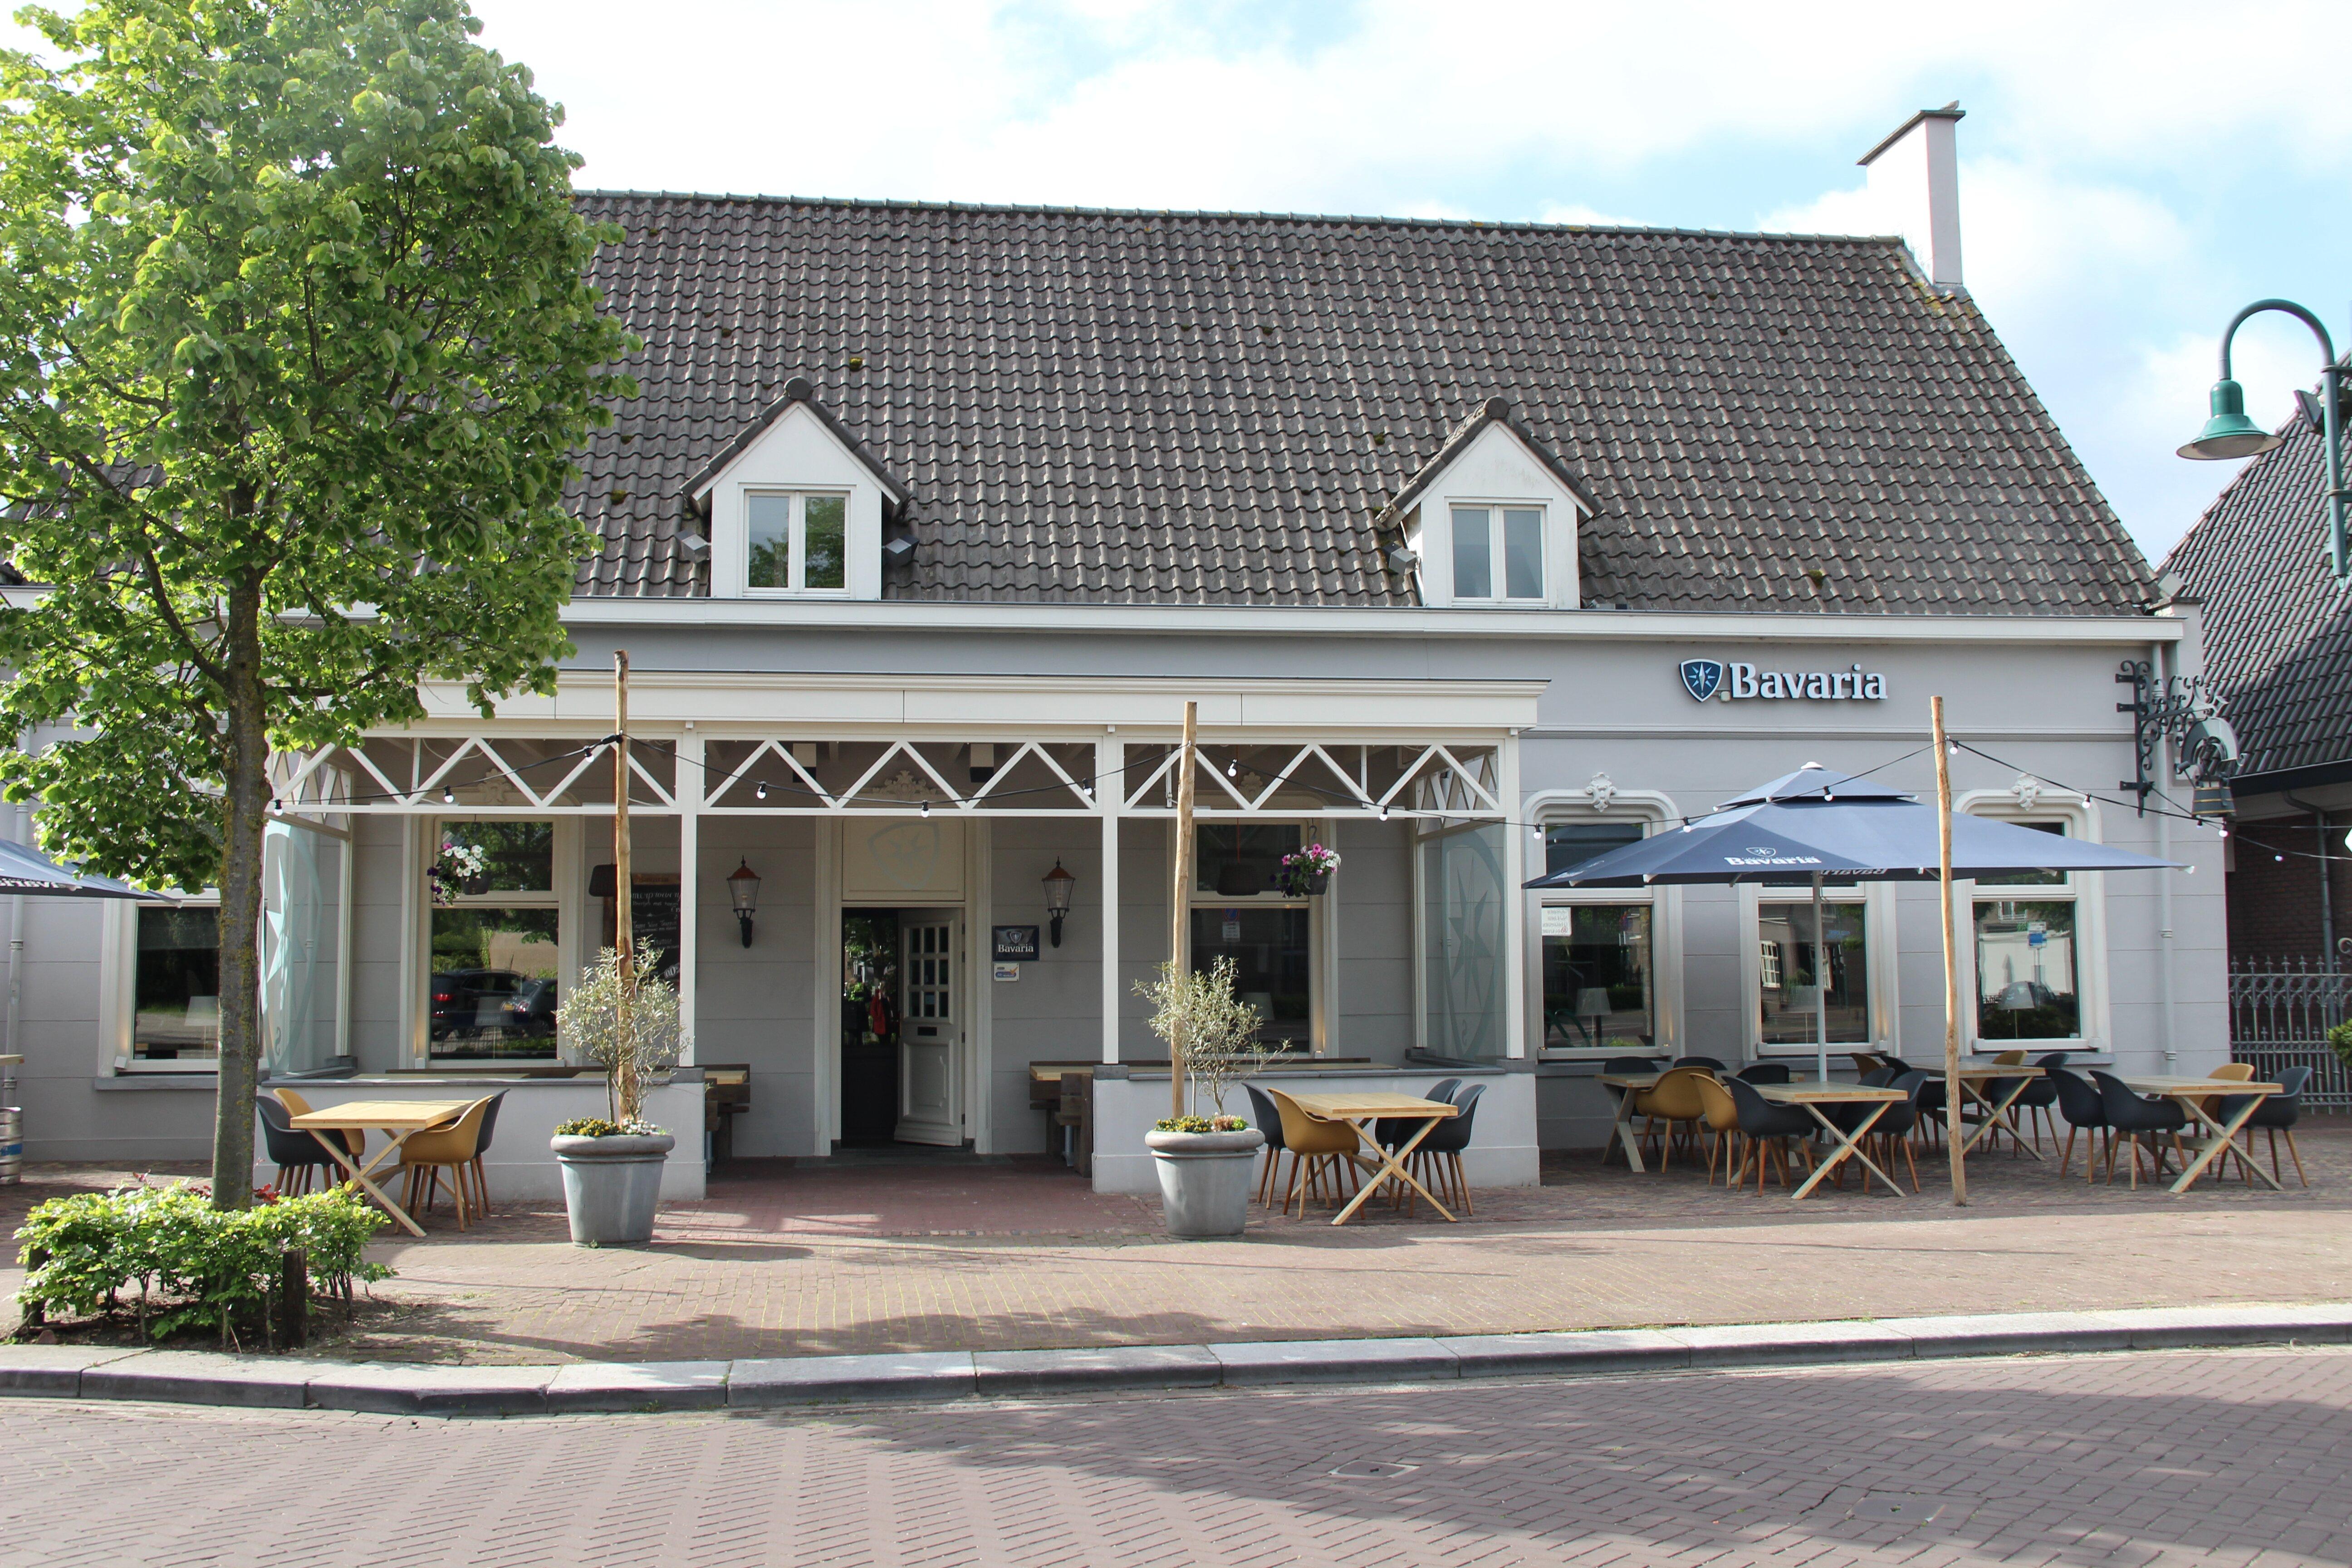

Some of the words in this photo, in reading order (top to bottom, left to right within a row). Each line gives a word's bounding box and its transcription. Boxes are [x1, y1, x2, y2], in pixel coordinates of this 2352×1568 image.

[1729, 663, 1888, 700] Bavaria
[1724, 857, 1822, 865] Bavaria
[998, 944, 1034, 952] Bavaria
